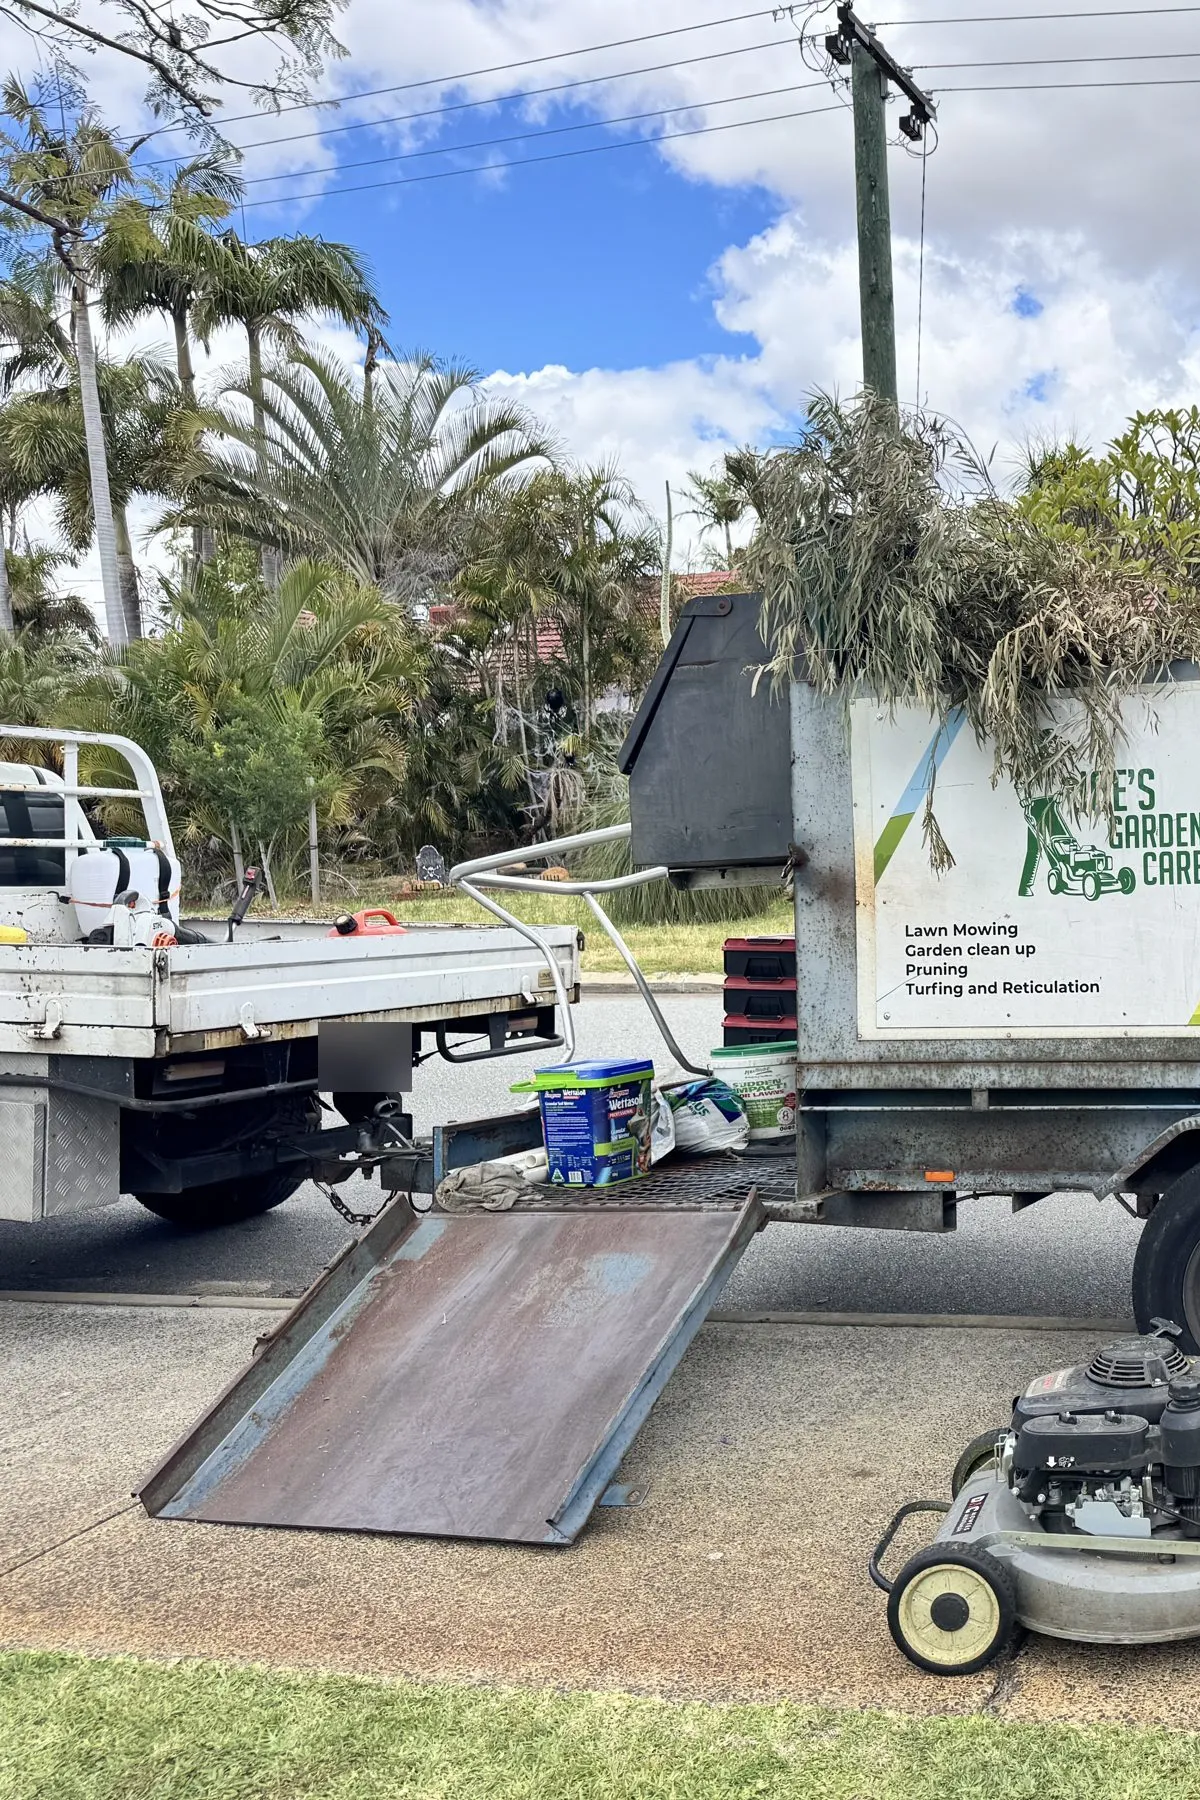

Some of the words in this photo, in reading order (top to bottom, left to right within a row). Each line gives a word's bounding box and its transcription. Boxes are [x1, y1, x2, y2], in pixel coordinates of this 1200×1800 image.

[904, 924, 948, 938] Lawn
[952, 921, 1019, 939] Mowing
[904, 943, 963, 957] Garden
[966, 942, 1010, 956] clean
[1014, 943, 1037, 958] up
[905, 961, 969, 978] Pruning
[905, 981, 964, 998] Turfing
[967, 980, 998, 995] and
[1002, 978, 1100, 995] Reticulation
[607, 1093, 643, 1111] Wettasoil
